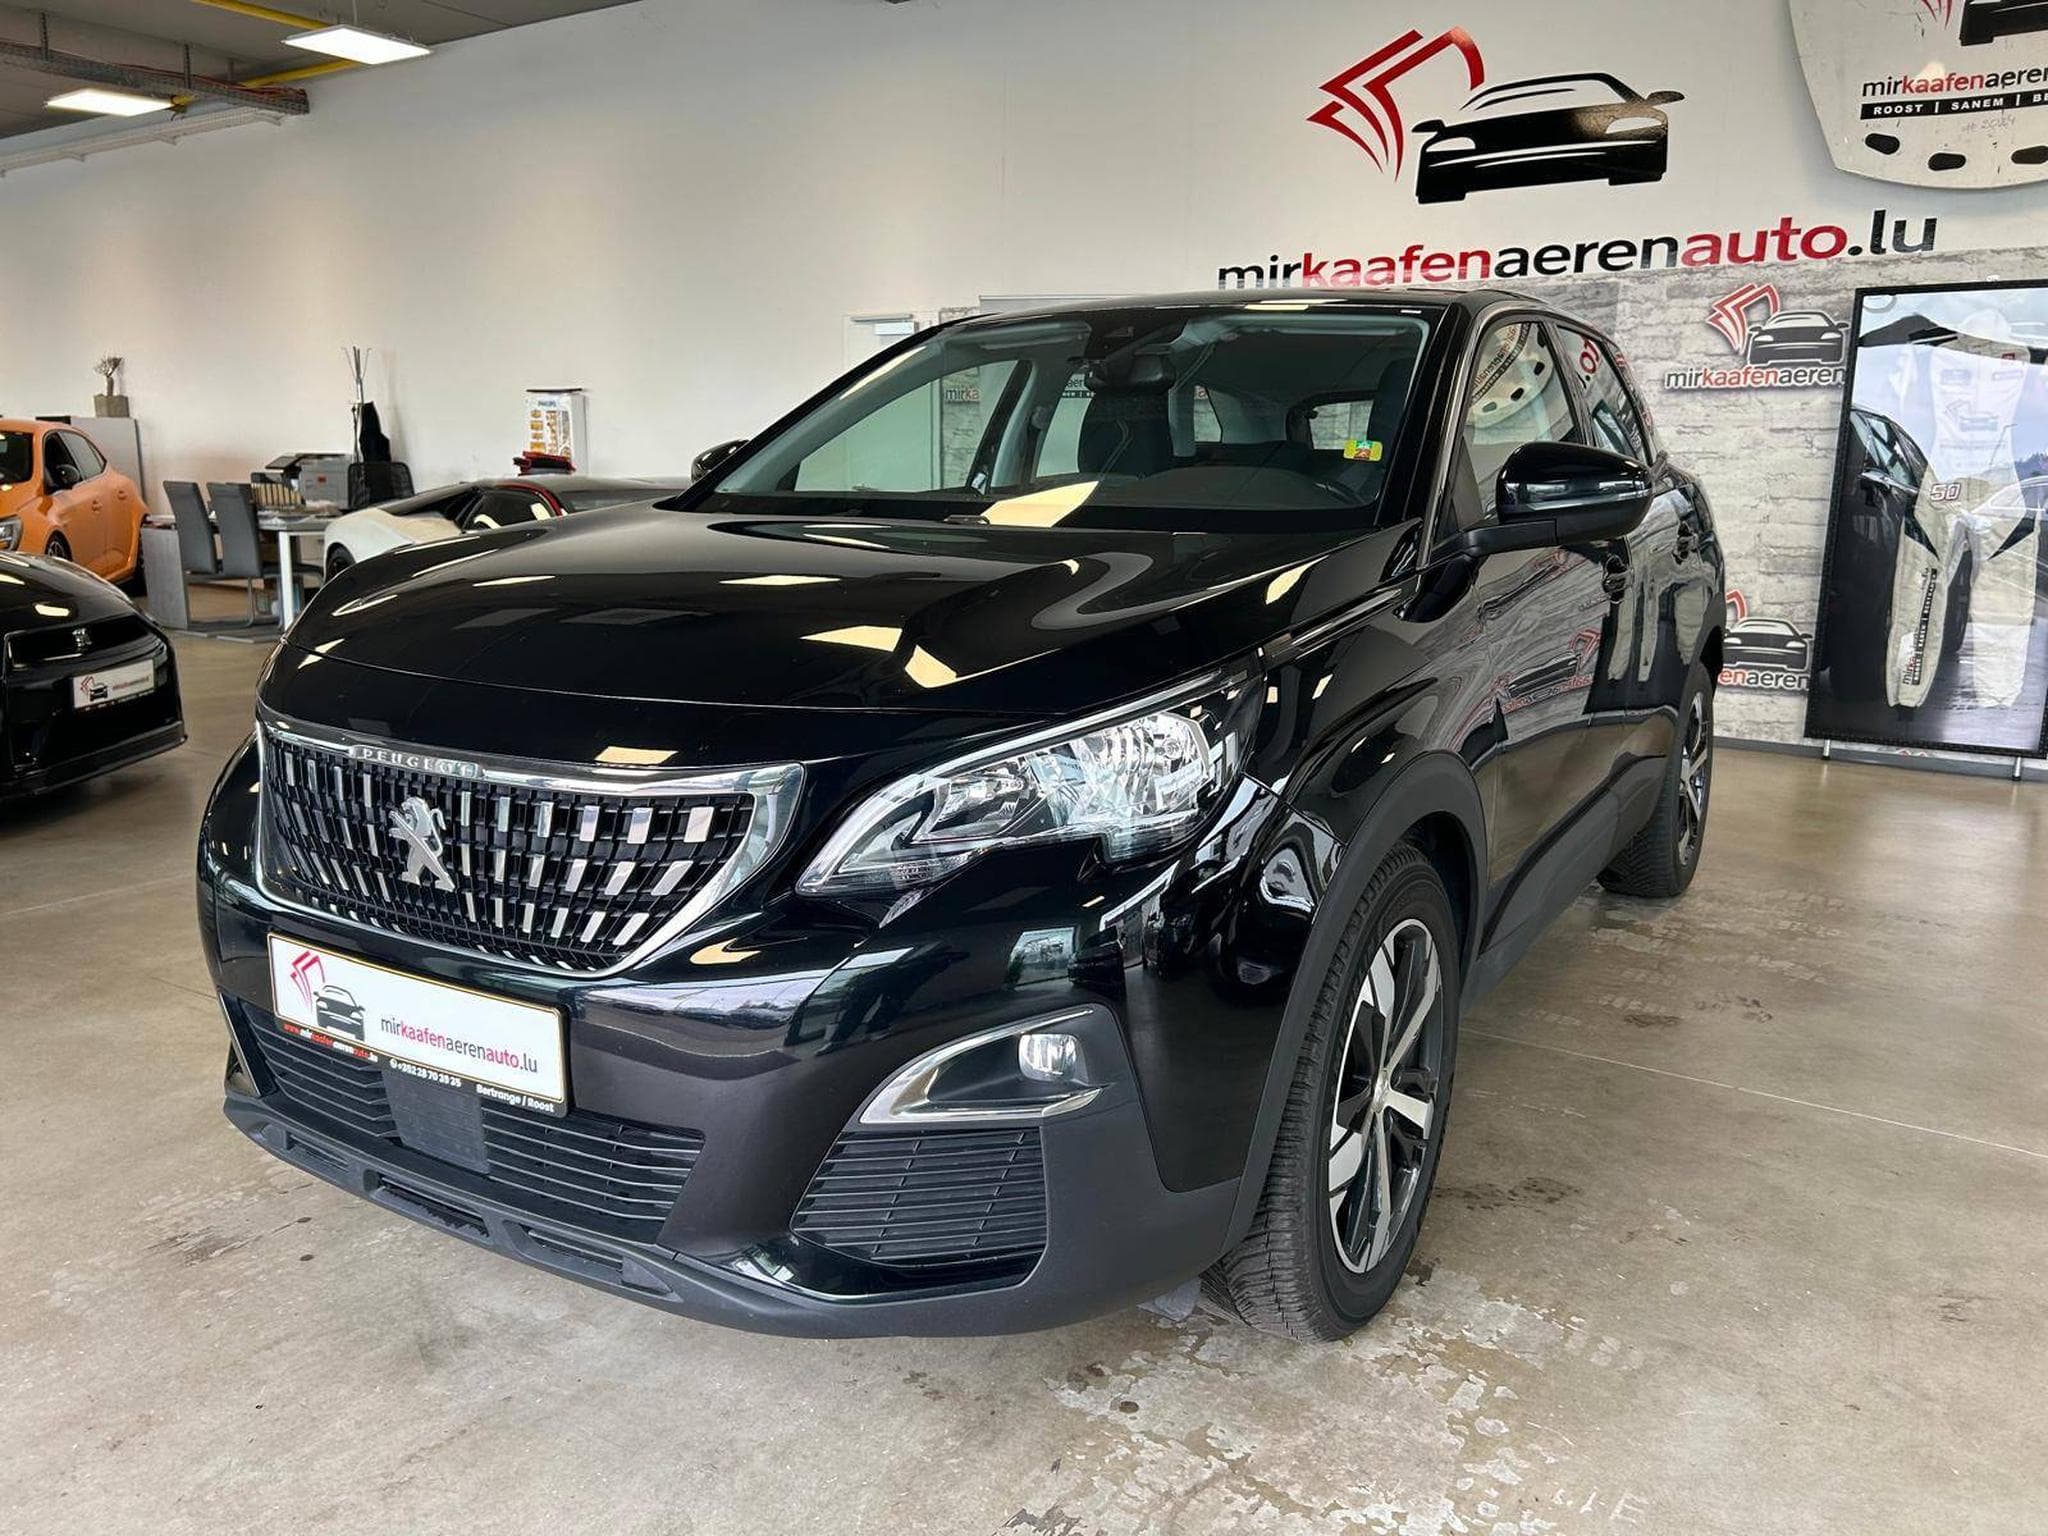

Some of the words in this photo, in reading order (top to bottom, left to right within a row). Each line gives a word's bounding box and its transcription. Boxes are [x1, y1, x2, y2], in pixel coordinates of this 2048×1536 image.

[1873, 104, 1924, 115] ROOST
[1951, 98, 2004, 111] SANEM
[1218, 209, 1937, 289] mirkaafenaerenauto.lu
[1929, 483, 1961, 501] 50
[363, 748, 477, 777] PEUGEOT
[381, 1017, 538, 1073] mirkaafenaerenauto.lu
[476, 1083, 521, 1105] Bertrange
[527, 1098, 555, 1113] Roost
